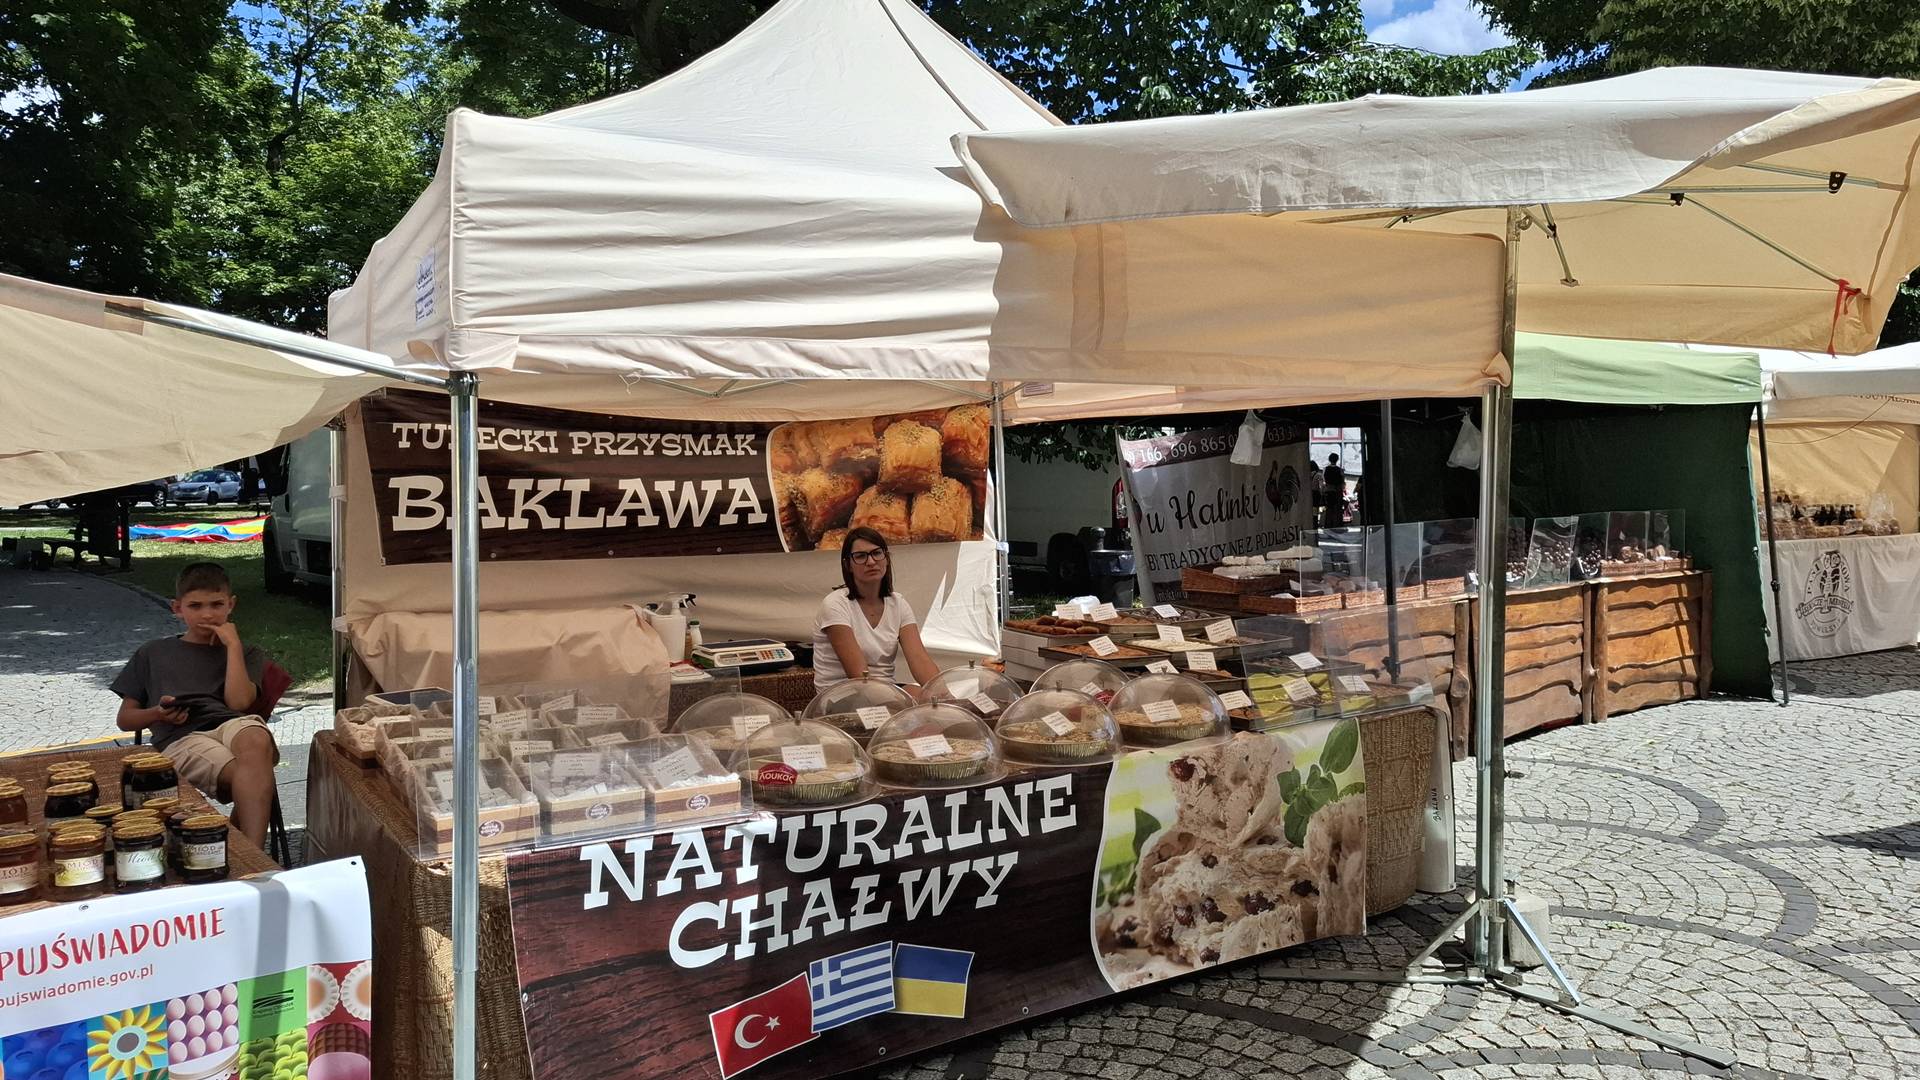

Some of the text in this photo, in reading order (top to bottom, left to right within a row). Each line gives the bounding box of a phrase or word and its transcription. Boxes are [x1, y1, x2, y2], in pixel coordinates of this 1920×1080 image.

[392, 423, 758, 456] TUECKI PRZYSMAK
[1170, 441, 1197, 458] 696
[1200, 436, 1226, 453] 865
[388, 475, 768, 531] BAKLAWA
[1146, 484, 1260, 534] u Halinki
[1161, 540, 1244, 571] TRADYCYNE
[579, 773, 1077, 911] NATURALNE
[668, 850, 1019, 969] CHAŁWY
